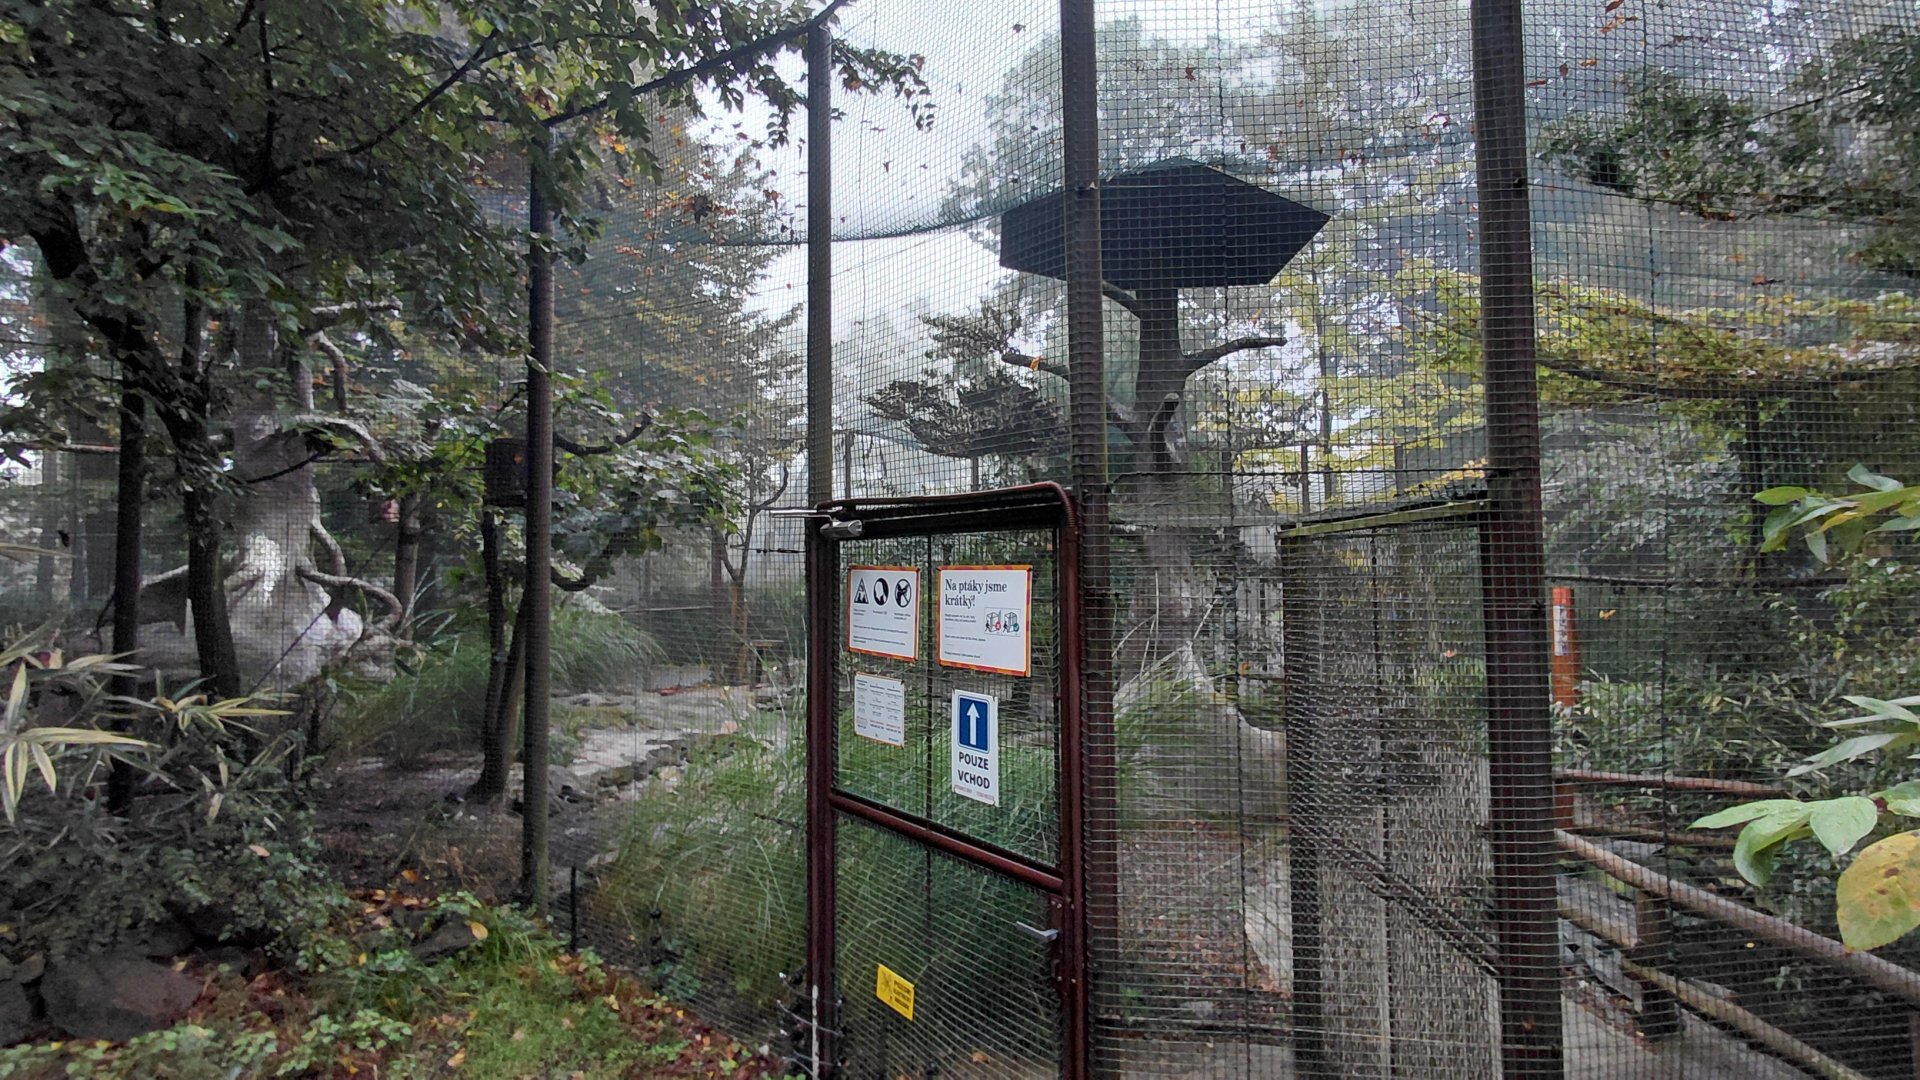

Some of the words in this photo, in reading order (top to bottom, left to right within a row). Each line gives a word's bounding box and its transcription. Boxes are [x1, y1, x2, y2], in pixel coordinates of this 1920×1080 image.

[945, 578, 957, 591] Na
[958, 579, 984, 594] ptáky
[984, 580, 1008, 594] jsme
[959, 751, 989, 770] POUZE
[957, 769, 990, 789] VCHOD
